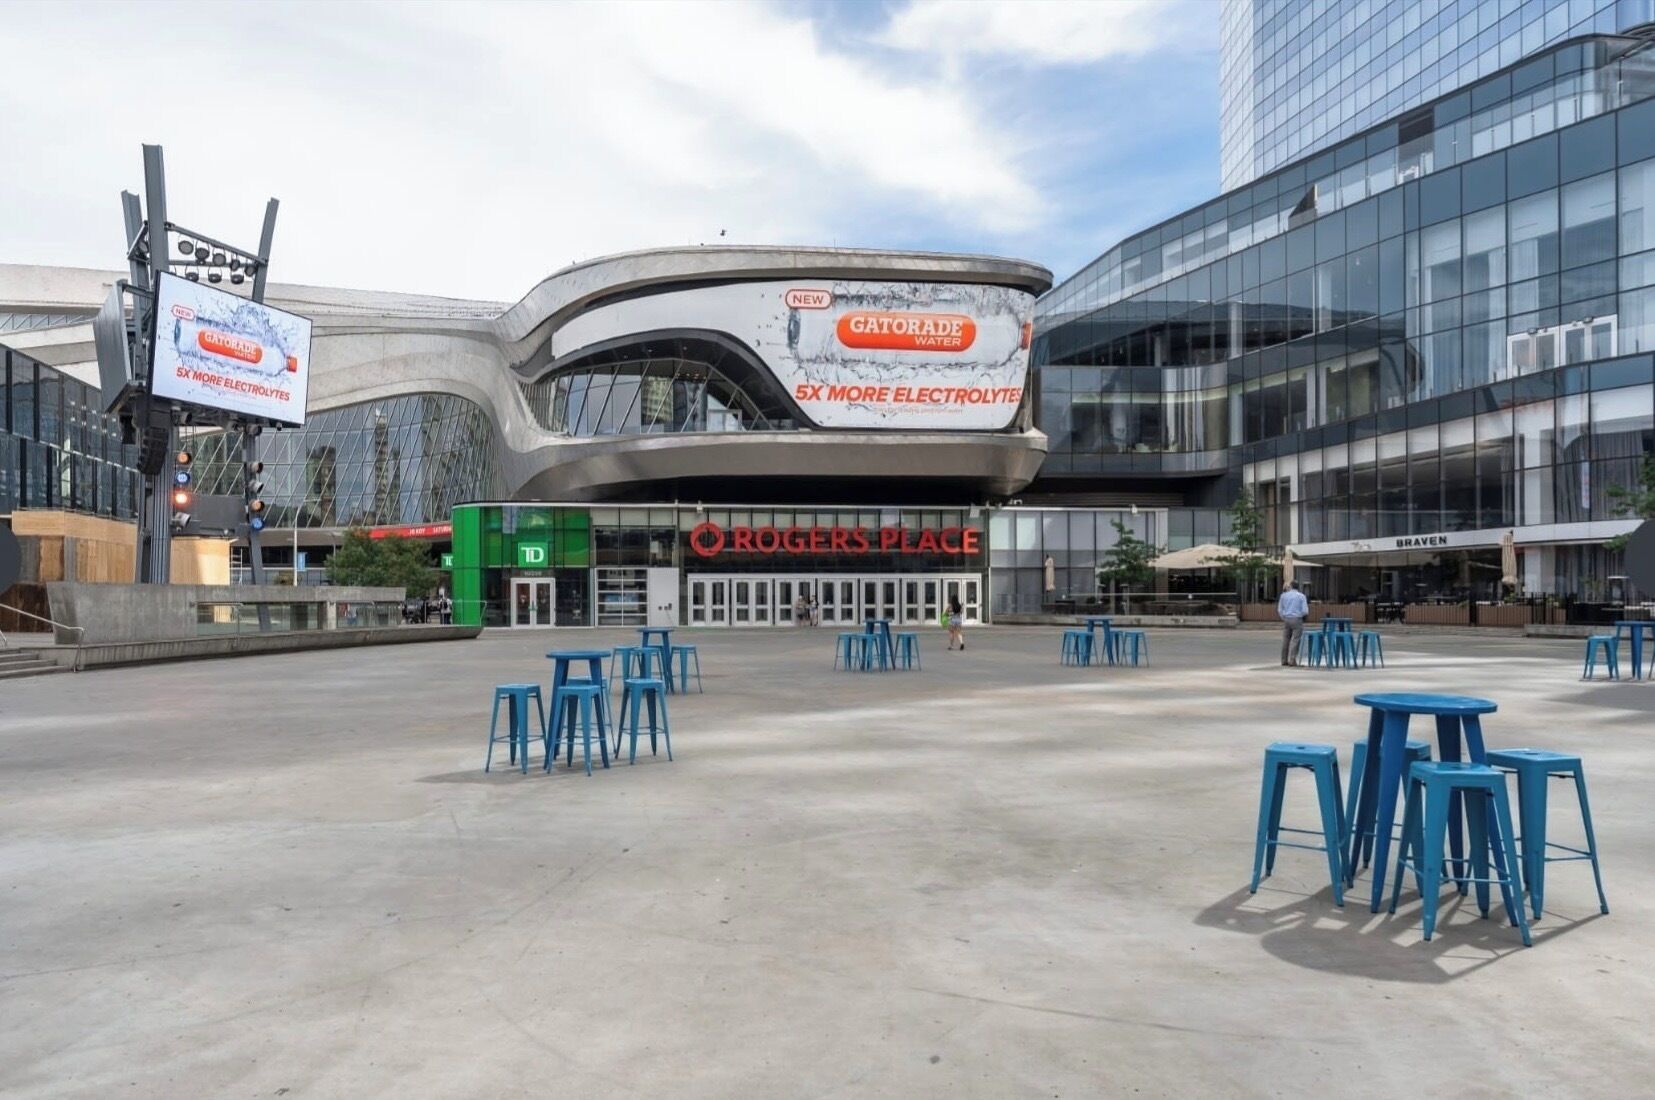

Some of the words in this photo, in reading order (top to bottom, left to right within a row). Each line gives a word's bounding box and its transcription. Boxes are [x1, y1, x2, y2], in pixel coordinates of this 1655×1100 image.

[792, 294, 824, 305] NEW
[175, 308, 191, 317] NEW
[850, 316, 963, 337] GATORADE
[204, 332, 257, 355] GATORADE
[914, 336, 962, 346] WATER
[176, 366, 190, 379] 5X
[193, 371, 223, 386] MORE
[224, 377, 290, 401] ELECTROLYTES
[795, 384, 824, 401] 5X
[827, 385, 887, 403] MORE
[893, 386, 1022, 404] ELECTROLYTES
[733, 526, 870, 554] ROGERS
[880, 526, 979, 554] PLACE
[1396, 536, 1447, 547] BRAVEN
[521, 547, 544, 562] TD
